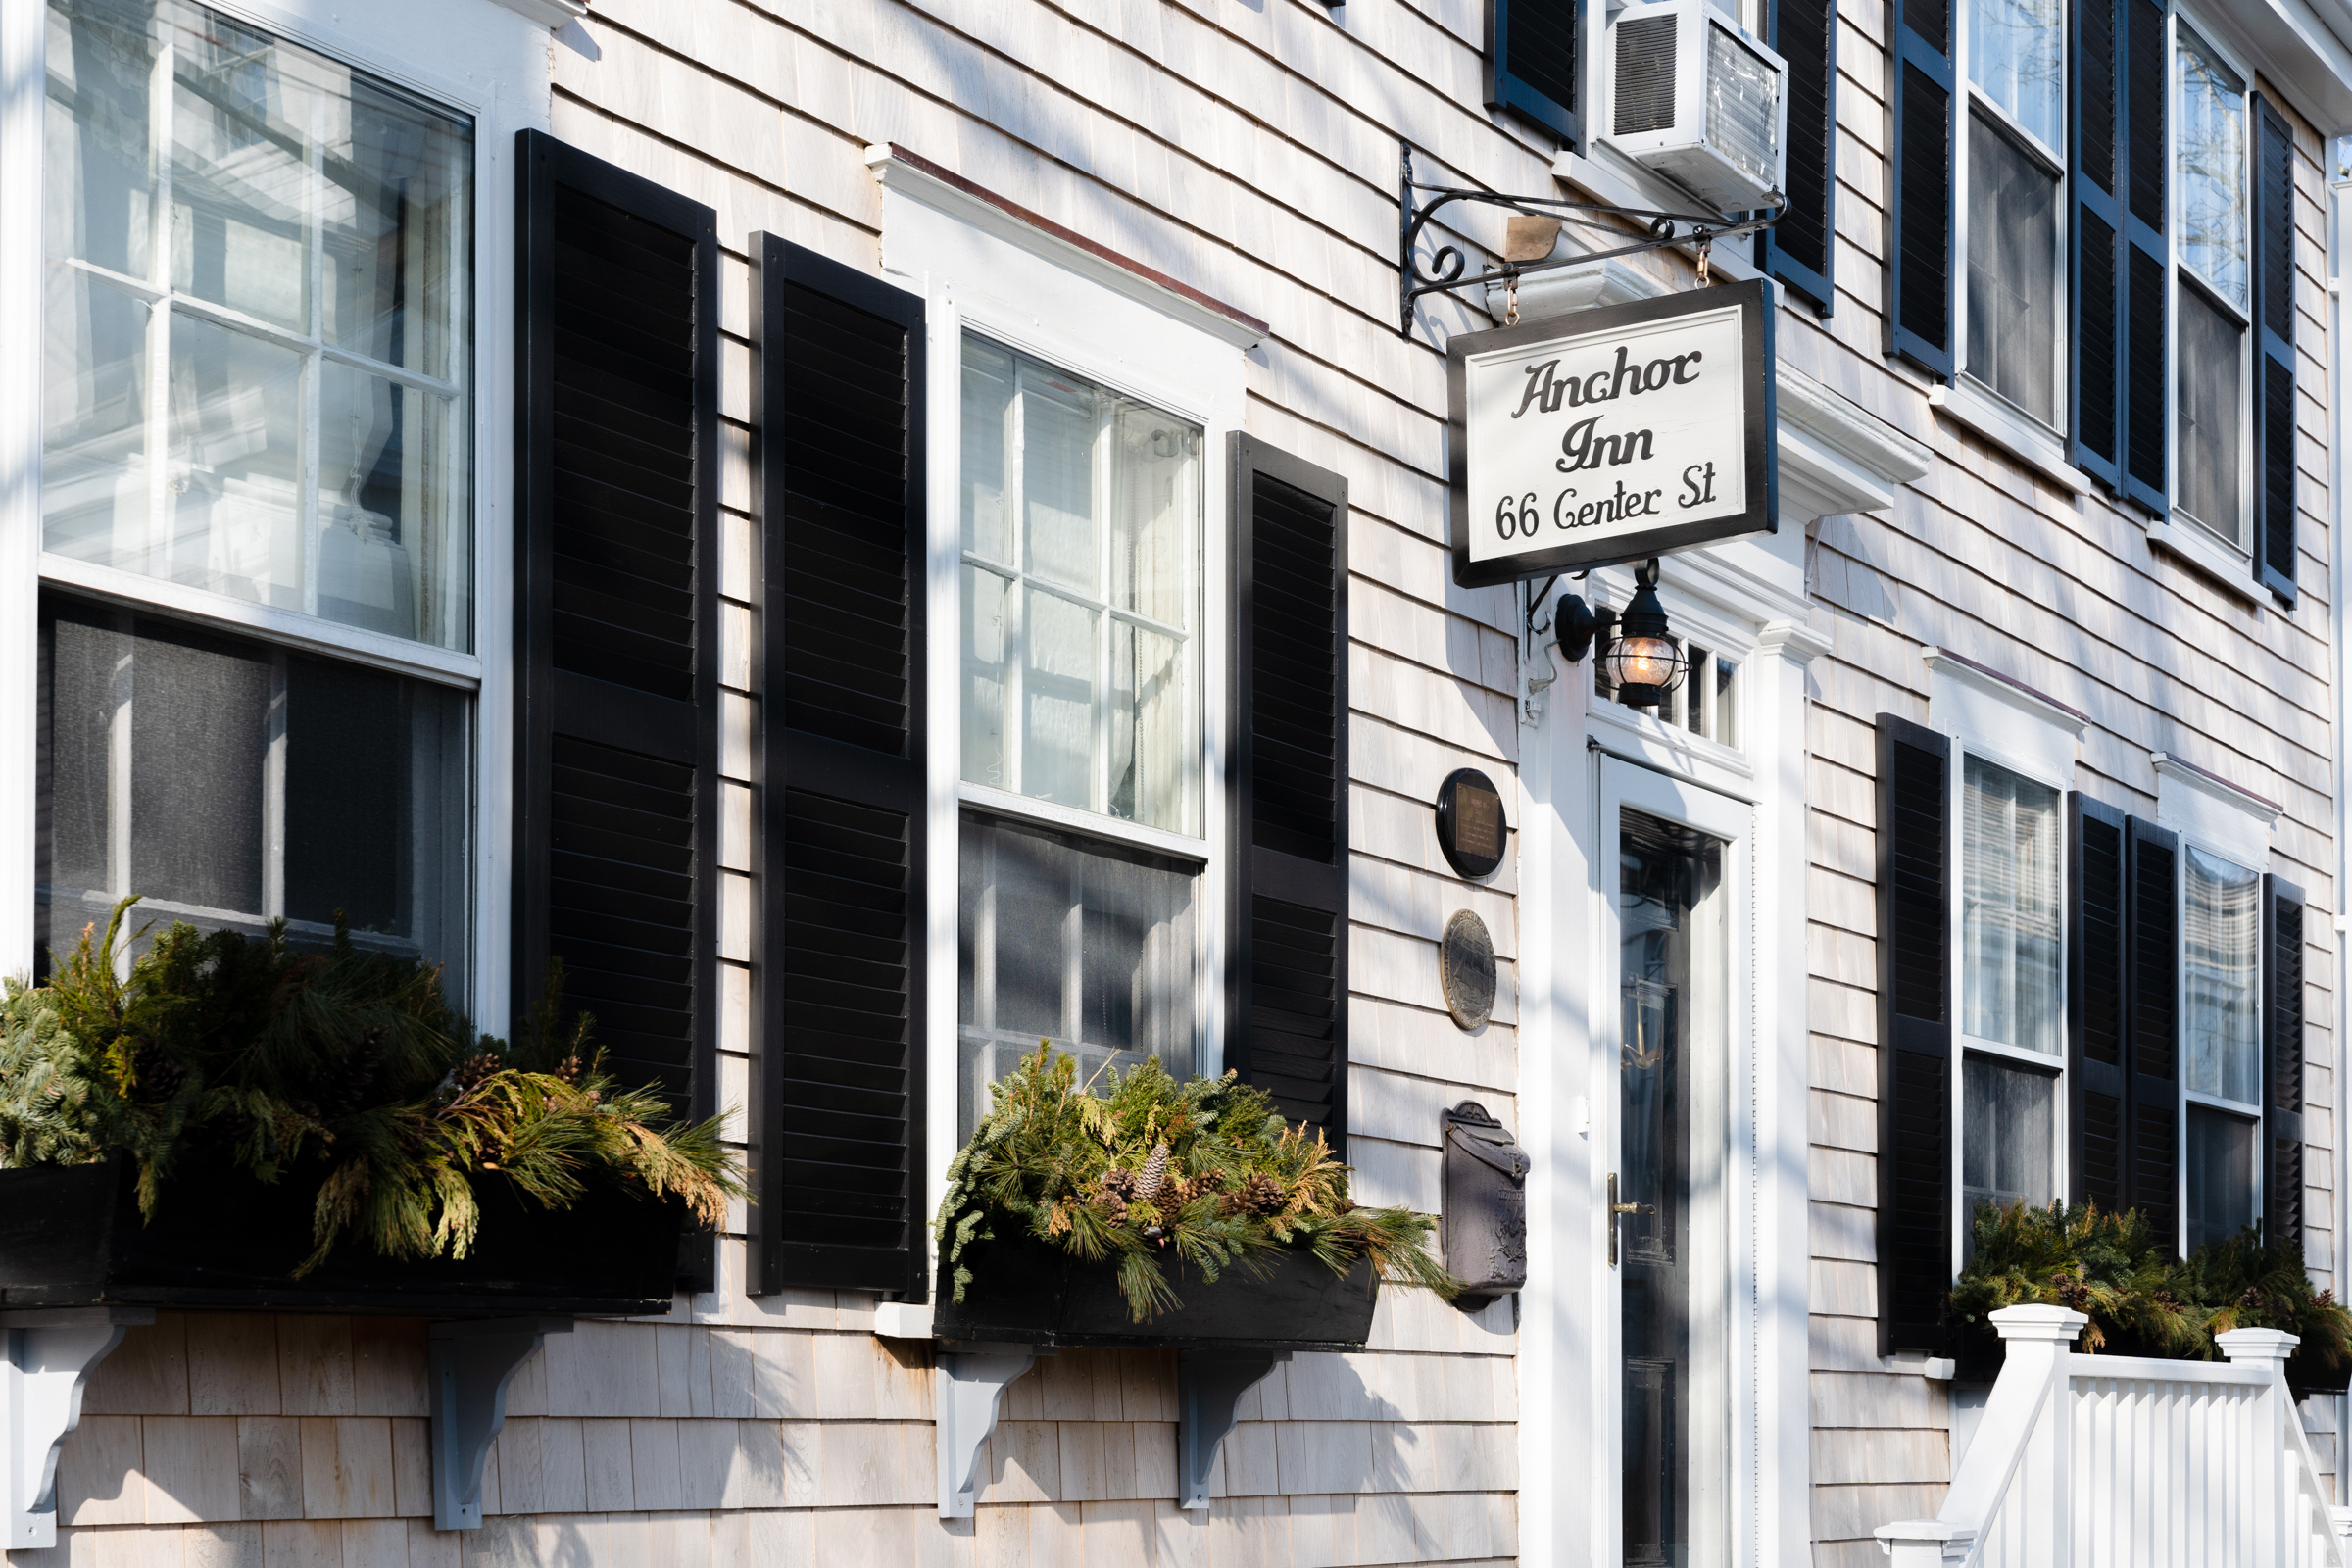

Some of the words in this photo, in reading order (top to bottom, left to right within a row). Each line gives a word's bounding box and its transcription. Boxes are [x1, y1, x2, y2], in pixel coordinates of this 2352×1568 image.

[1511, 346, 1702, 418] Anchor
[1556, 415, 1654, 473] Inn
[1495, 492, 1540, 540] 66
[1553, 480, 1662, 529] Center
[1678, 461, 1717, 509] St
